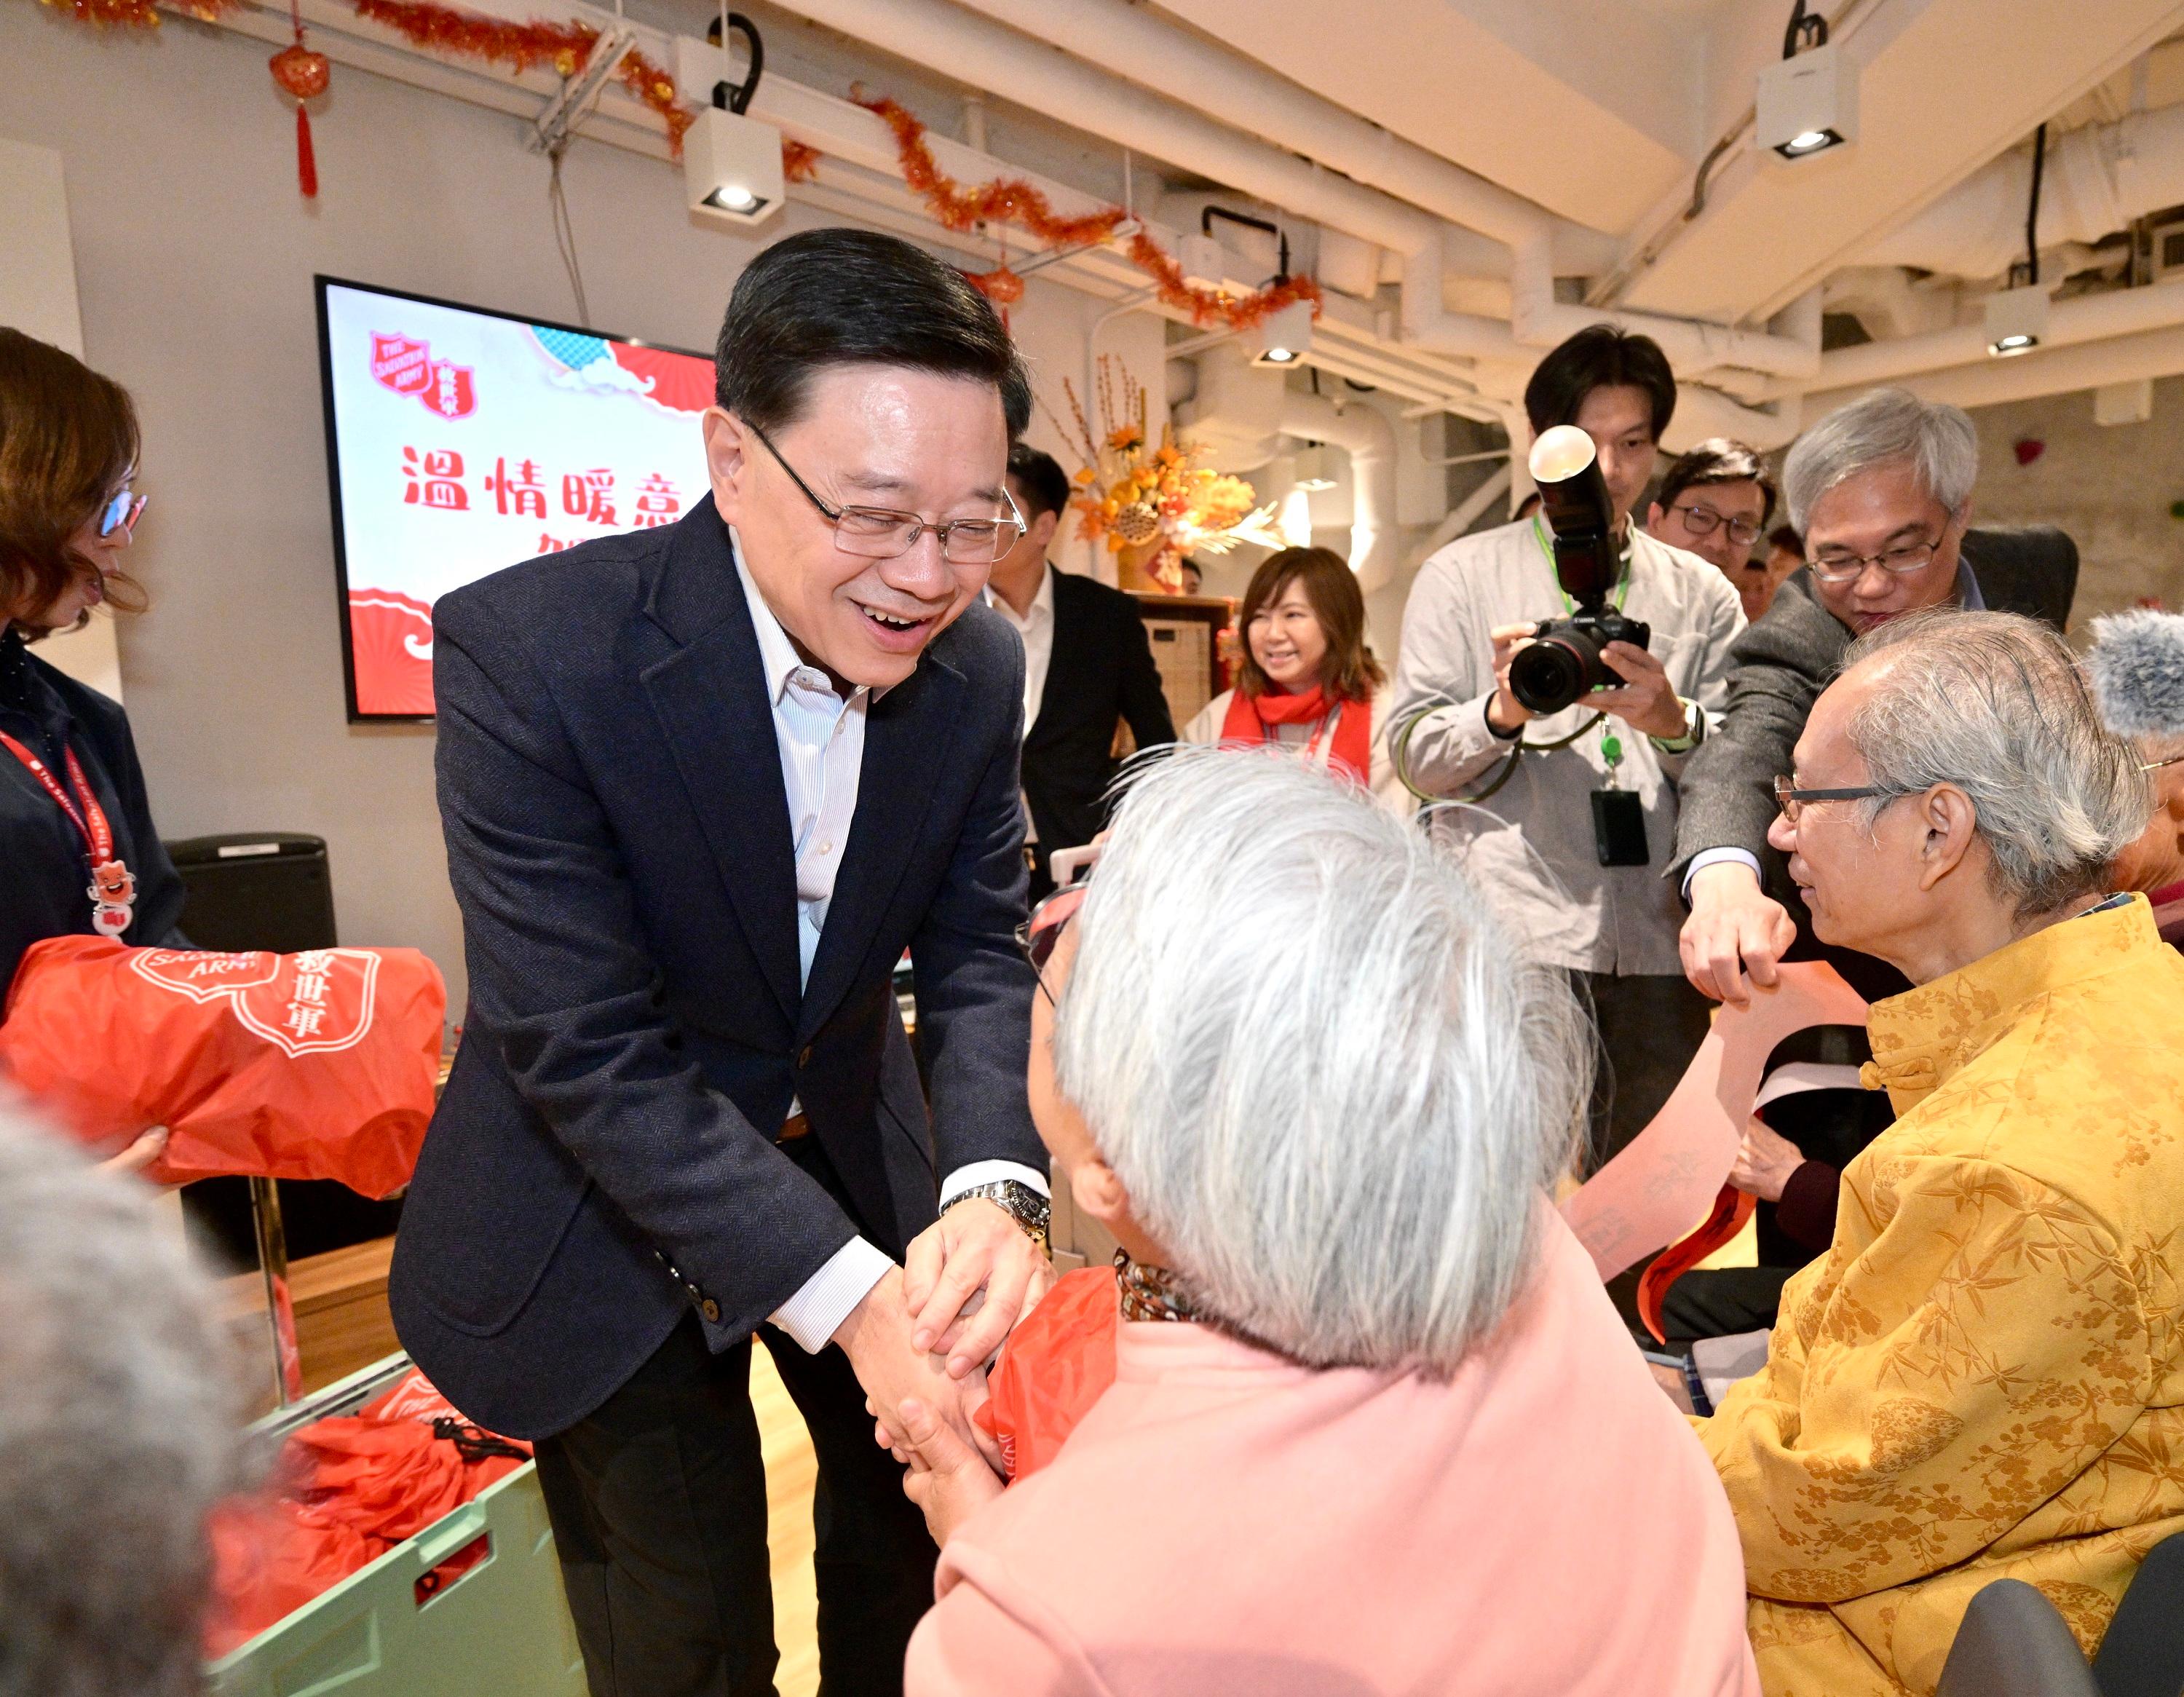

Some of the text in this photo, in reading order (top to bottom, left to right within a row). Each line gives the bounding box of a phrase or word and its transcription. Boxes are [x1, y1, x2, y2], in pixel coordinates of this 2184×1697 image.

[40, 770, 55, 788] The
[282, 949, 336, 1037] 救世軍
